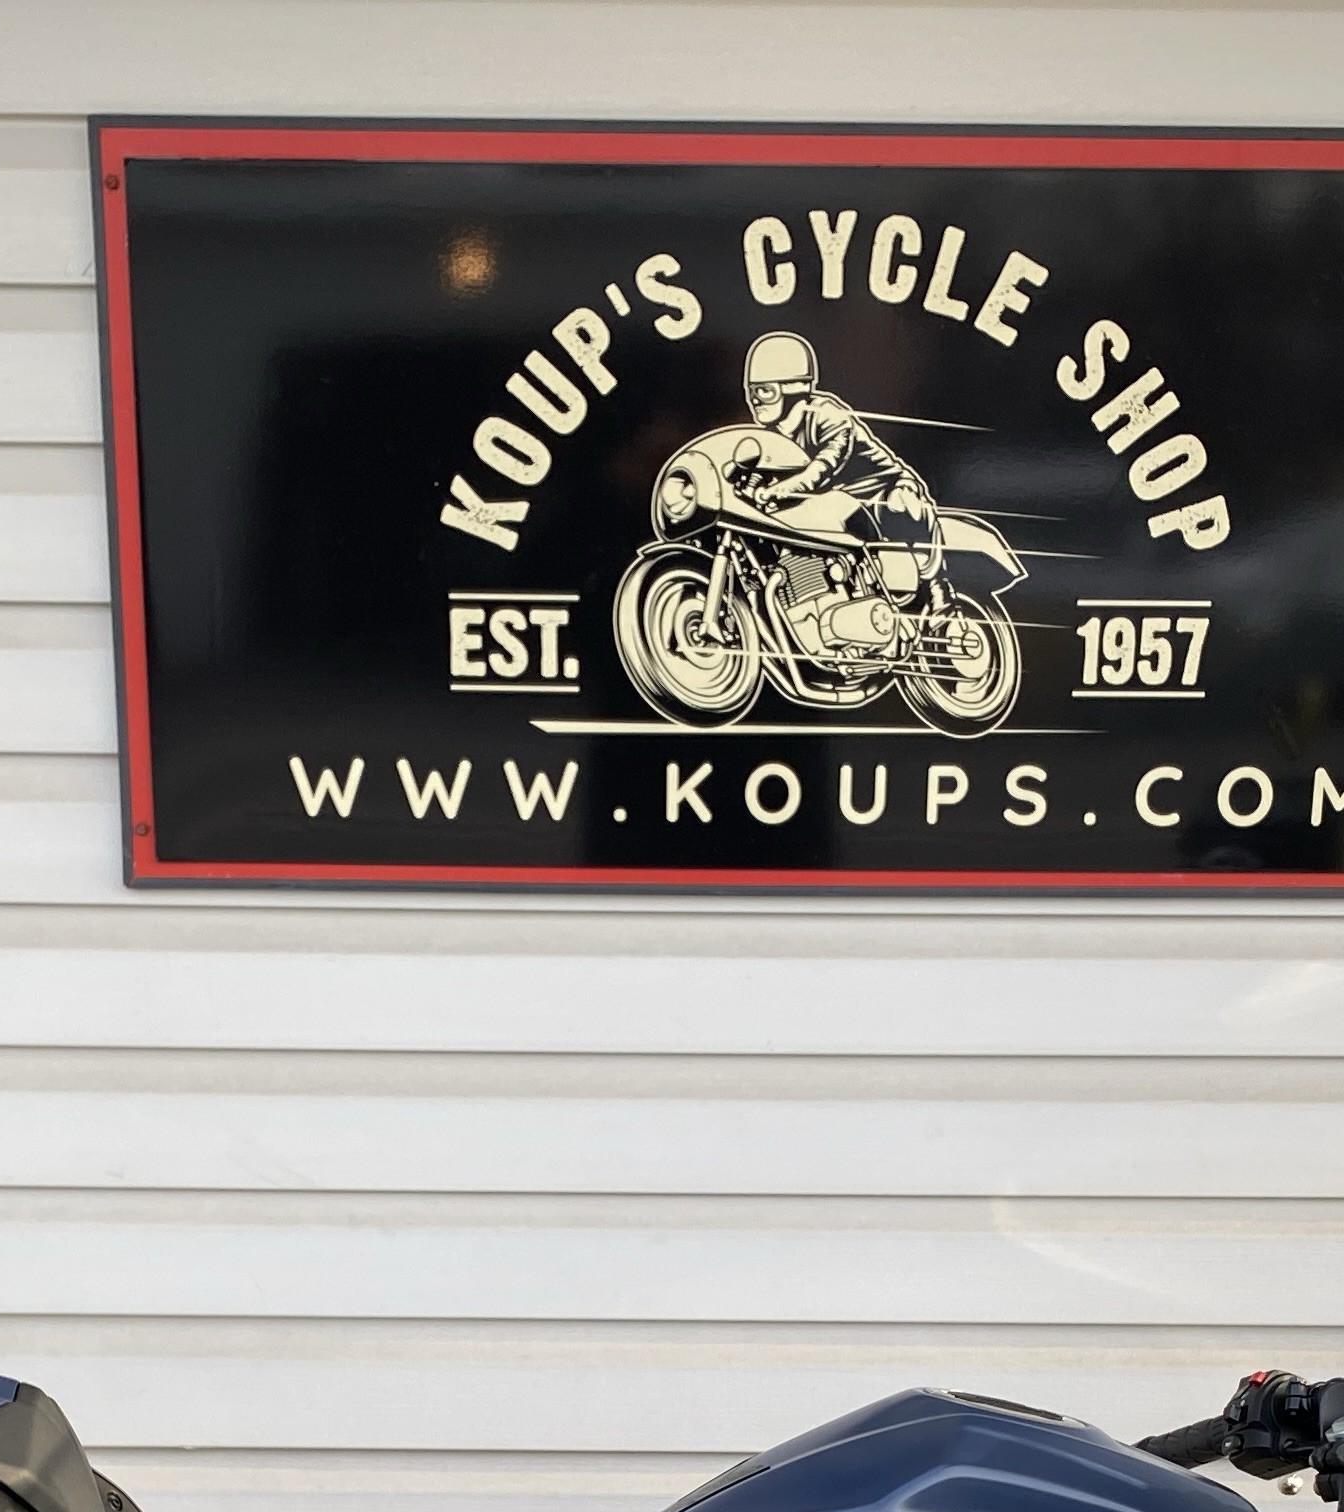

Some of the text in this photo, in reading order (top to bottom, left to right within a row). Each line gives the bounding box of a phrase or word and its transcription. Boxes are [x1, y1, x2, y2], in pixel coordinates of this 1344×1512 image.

[439, 209, 1231, 551] KOUP'S CYCLE SHOP
[451, 609, 579, 680] EST.
[1074, 616, 1212, 688] 1957
